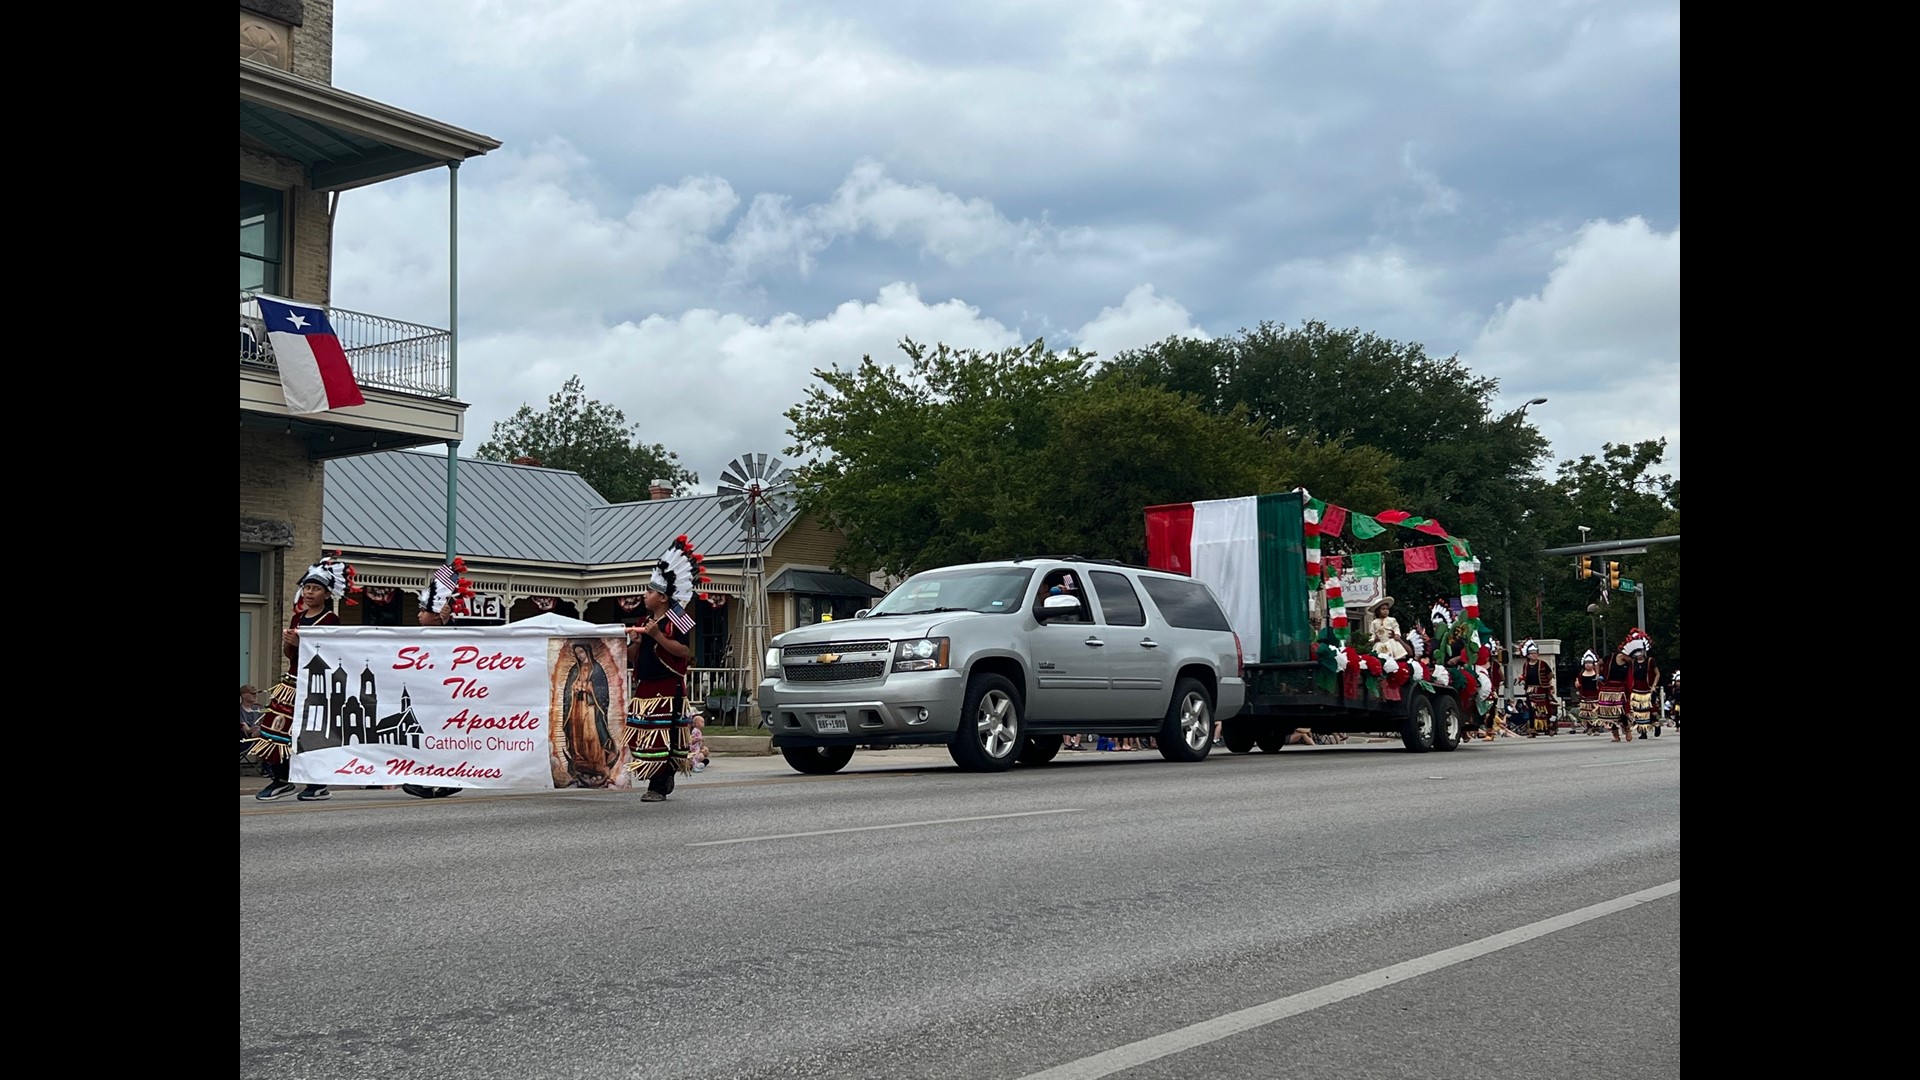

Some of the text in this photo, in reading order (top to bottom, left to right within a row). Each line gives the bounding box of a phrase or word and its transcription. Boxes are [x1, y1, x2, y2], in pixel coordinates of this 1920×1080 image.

[392, 645, 526, 671] St. Peter
[443, 677, 489, 699] The
[442, 709, 540, 733] Apostle
[424, 735, 535, 752] Catholic Church
[335, 758, 503, 779] Los Matachines
